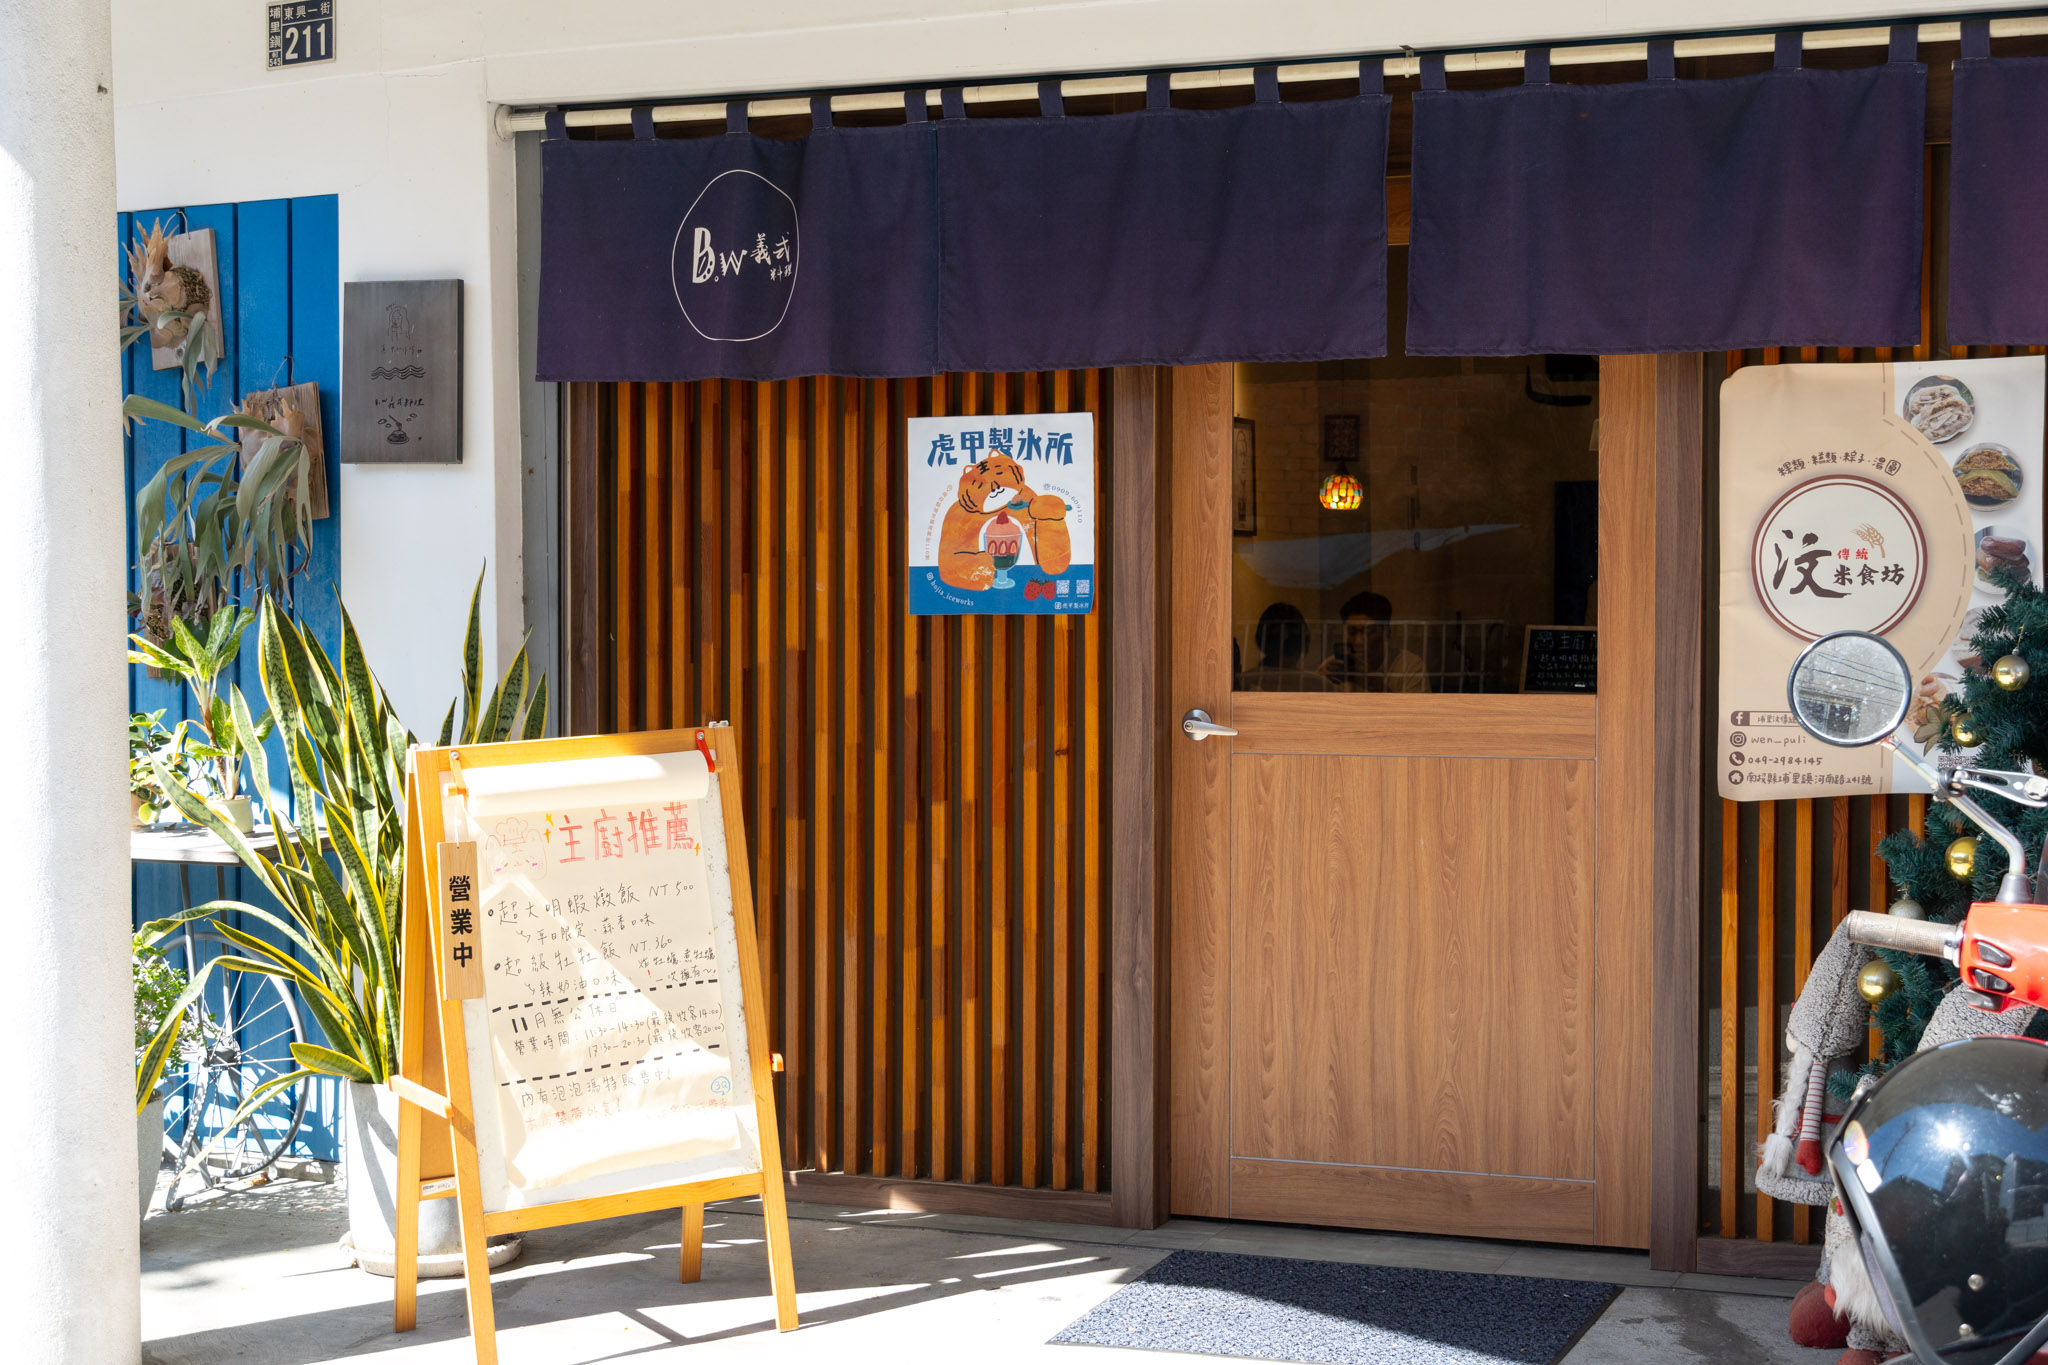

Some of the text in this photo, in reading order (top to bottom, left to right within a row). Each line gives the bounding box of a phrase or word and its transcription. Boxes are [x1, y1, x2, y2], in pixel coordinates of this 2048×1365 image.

[284, 2, 330, 21] 東興一街
[285, 23, 326, 60] 211
[269, 57, 281, 67] 545
[1772, 529, 1853, 599] 汶
[1836, 547, 1869, 561] 傳統
[1832, 563, 1905, 587] 米食坊
[1750, 735, 1807, 747] wen_puli
[1747, 755, 1824, 767] 049-2984145
[558, 801, 695, 864] 主廚推薦
[449, 875, 473, 968] 營業中
